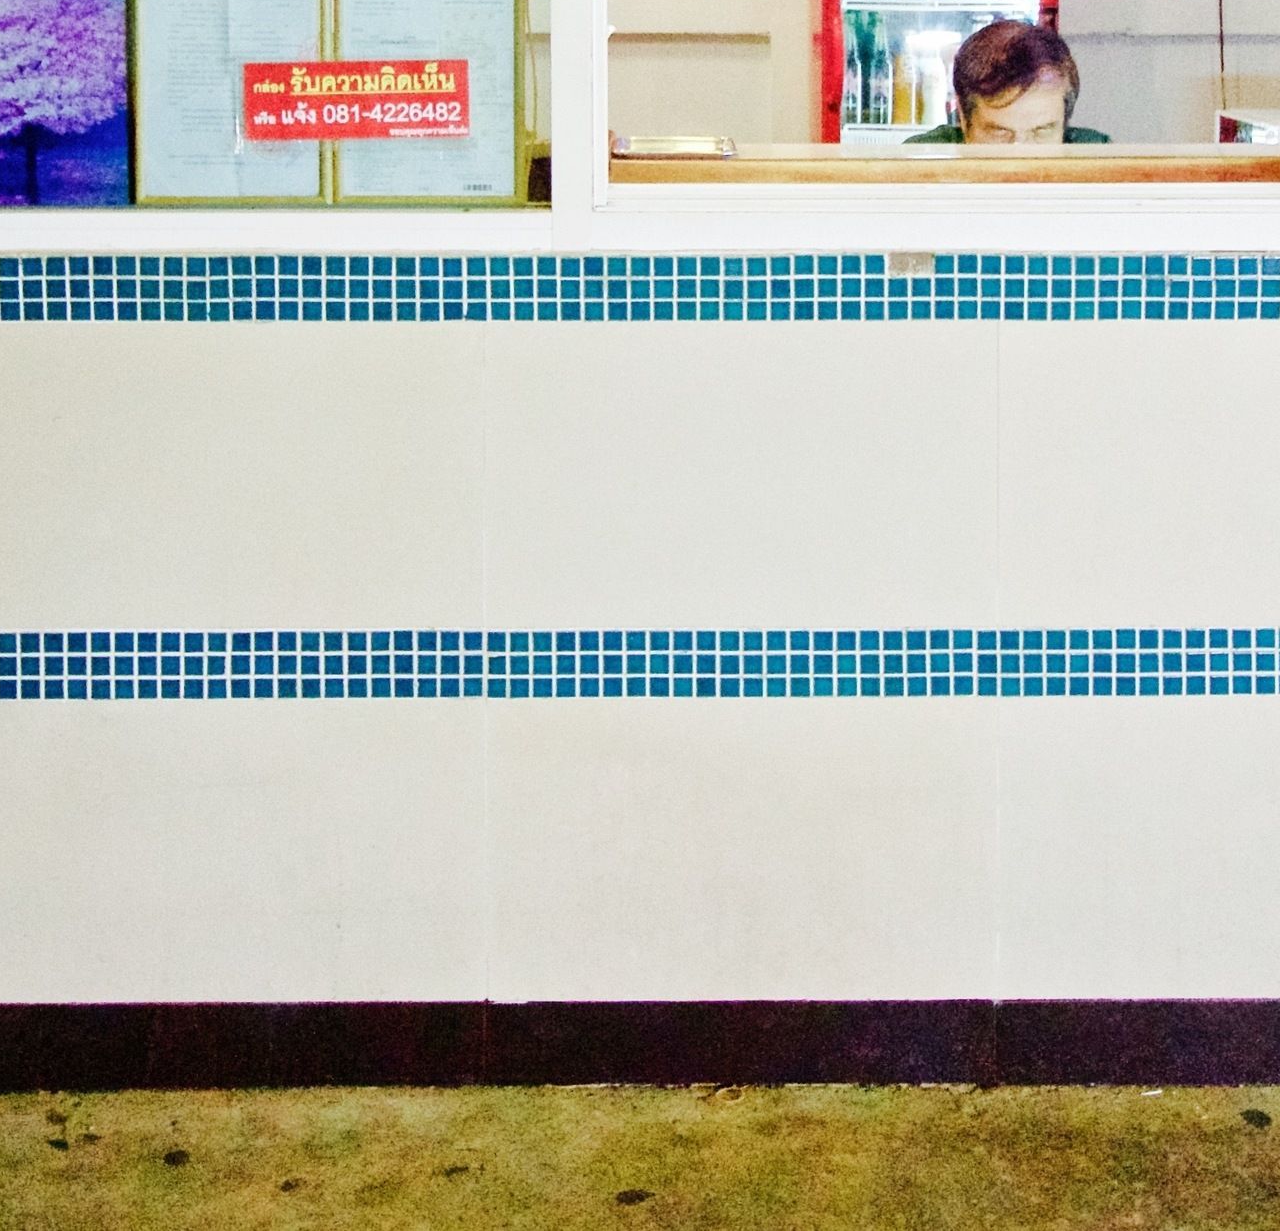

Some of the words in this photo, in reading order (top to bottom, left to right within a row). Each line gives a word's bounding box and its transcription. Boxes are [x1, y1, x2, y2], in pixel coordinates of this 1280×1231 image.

[253, 81, 285, 94] กล่อง
[290, 63, 455, 93] รับความคิดเห็น
[282, 103, 316, 125] แจ้ง
[322, 102, 462, 124] 081-4226482
